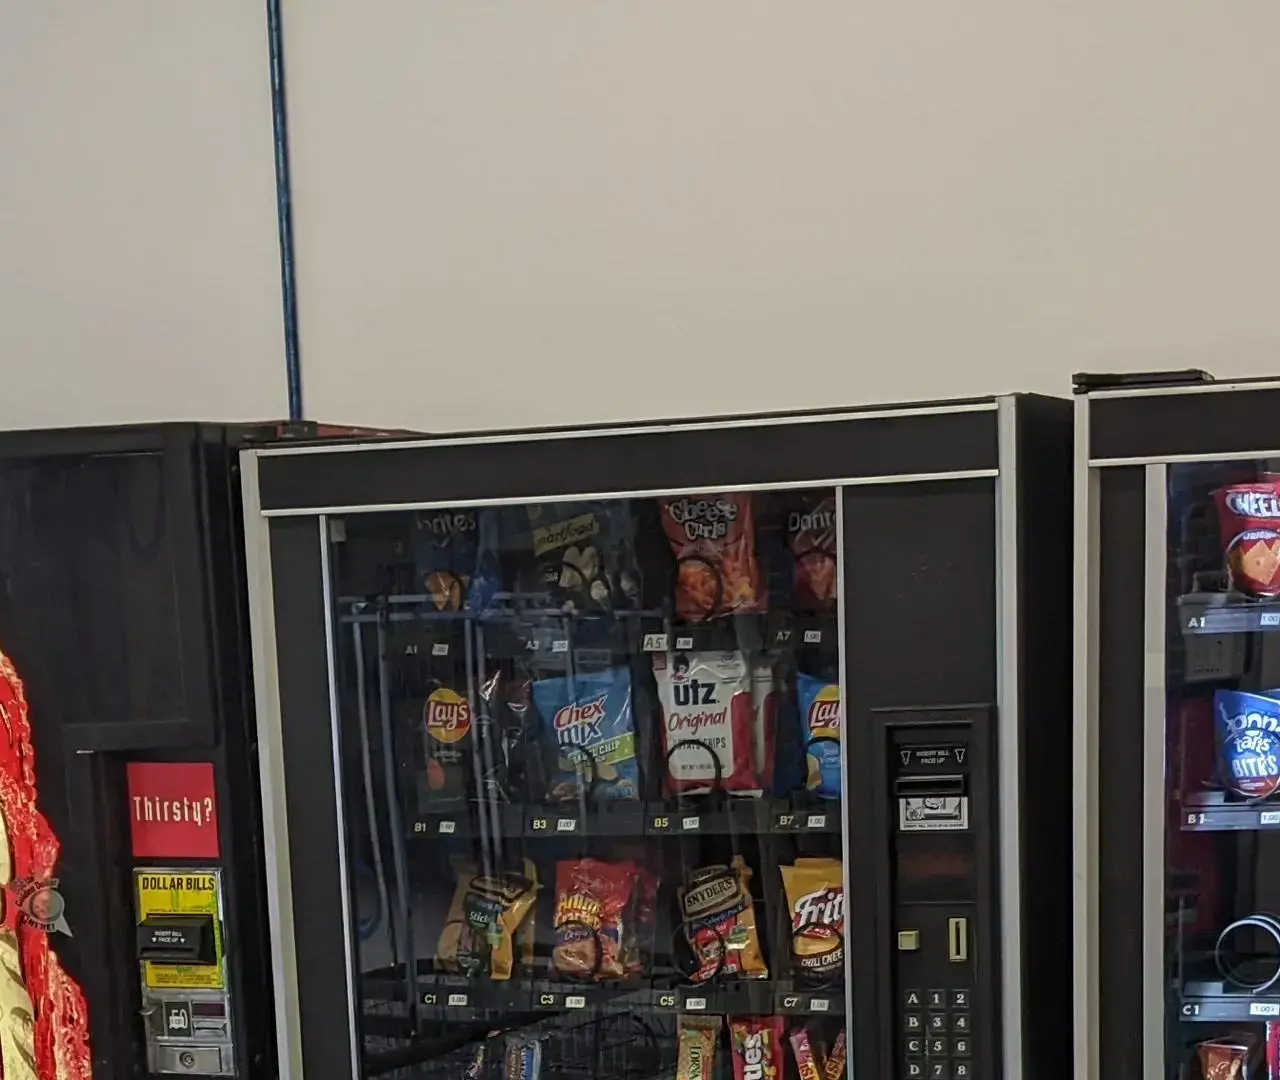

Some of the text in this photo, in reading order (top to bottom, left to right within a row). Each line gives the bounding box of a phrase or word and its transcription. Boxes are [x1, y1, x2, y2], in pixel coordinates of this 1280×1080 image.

[669, 500, 738, 524] Cheese
[787, 512, 836, 532] Dorit
[684, 521, 726, 541] Curls
[1189, 617, 1205, 627] A1
[644, 636, 662, 648] A5
[426, 701, 471, 730] Lay's
[553, 694, 608, 729] Chex
[809, 700, 840, 729] Lay
[668, 707, 728, 735] Original
[133, 796, 213, 827] Thirsty?
[1188, 814, 1204, 823] B1
[655, 818, 668, 827] B5
[780, 816, 793, 825] B7
[142, 877, 215, 891] DOLLAR BILLS
[796, 886, 844, 928] Frit
[821, 949, 844, 966] CHEE
[541, 995, 553, 1004] C3
[661, 996, 673, 1005] C5
[784, 998, 798, 1007] C7
[1183, 1005, 1199, 1014] C1
